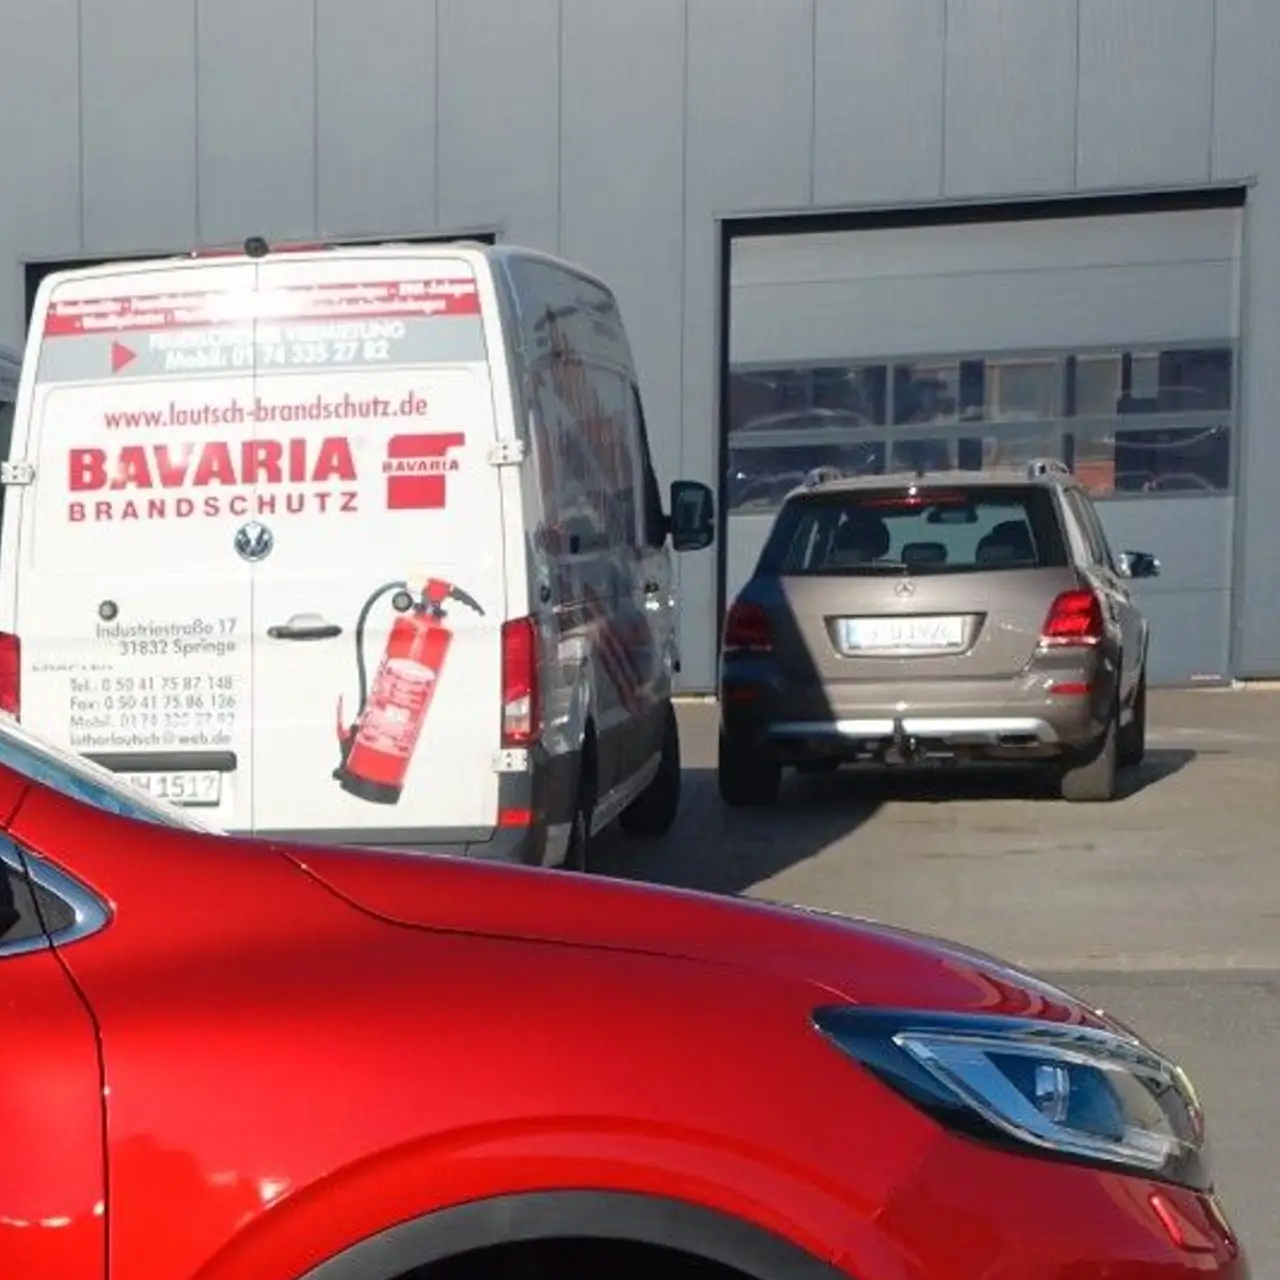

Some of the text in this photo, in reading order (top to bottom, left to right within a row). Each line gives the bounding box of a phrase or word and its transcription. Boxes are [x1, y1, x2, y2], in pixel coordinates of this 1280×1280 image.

[104, 390, 428, 429] www.lautsch-brandschutz.de
[69, 436, 358, 491] BAVARIA
[381, 459, 460, 474] BAVARIA
[68, 491, 358, 522] BRANDSCHUTZ
[219, 617, 237, 635] 17
[120, 639, 237, 658] 31832 Springe
[156, 775, 216, 799] 1517
